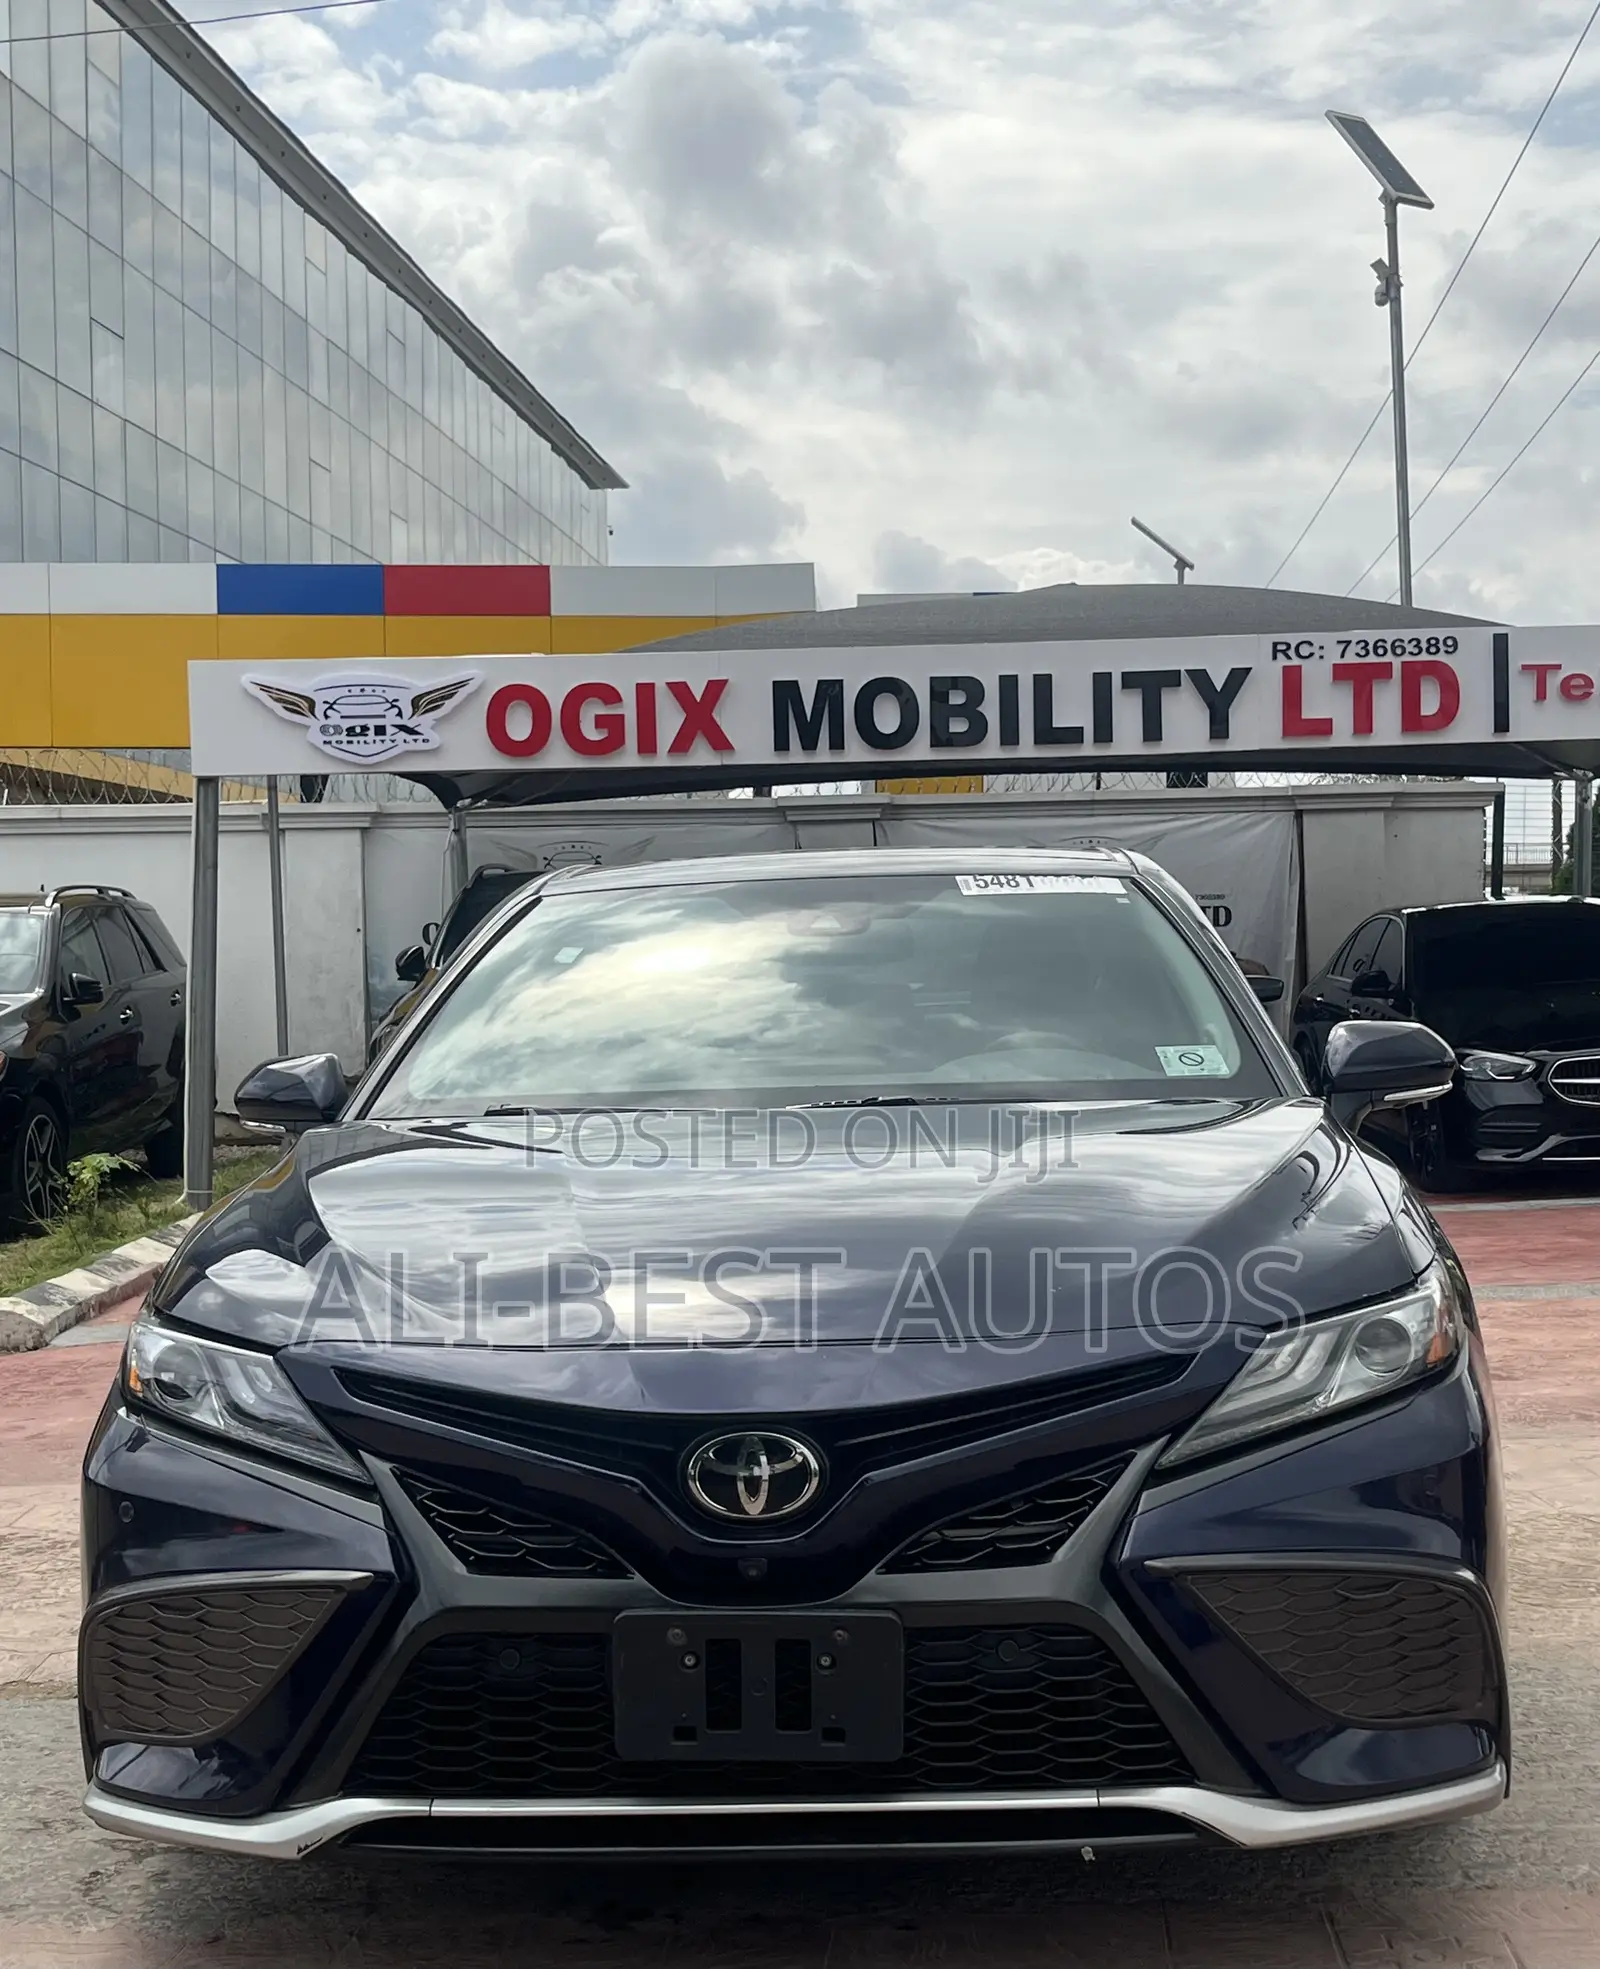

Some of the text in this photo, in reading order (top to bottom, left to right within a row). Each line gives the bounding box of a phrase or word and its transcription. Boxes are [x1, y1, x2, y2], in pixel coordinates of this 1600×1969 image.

[1271, 636, 1459, 661] RC: 7366389
[486, 660, 1461, 758] OGIX MOBILITY LTD
